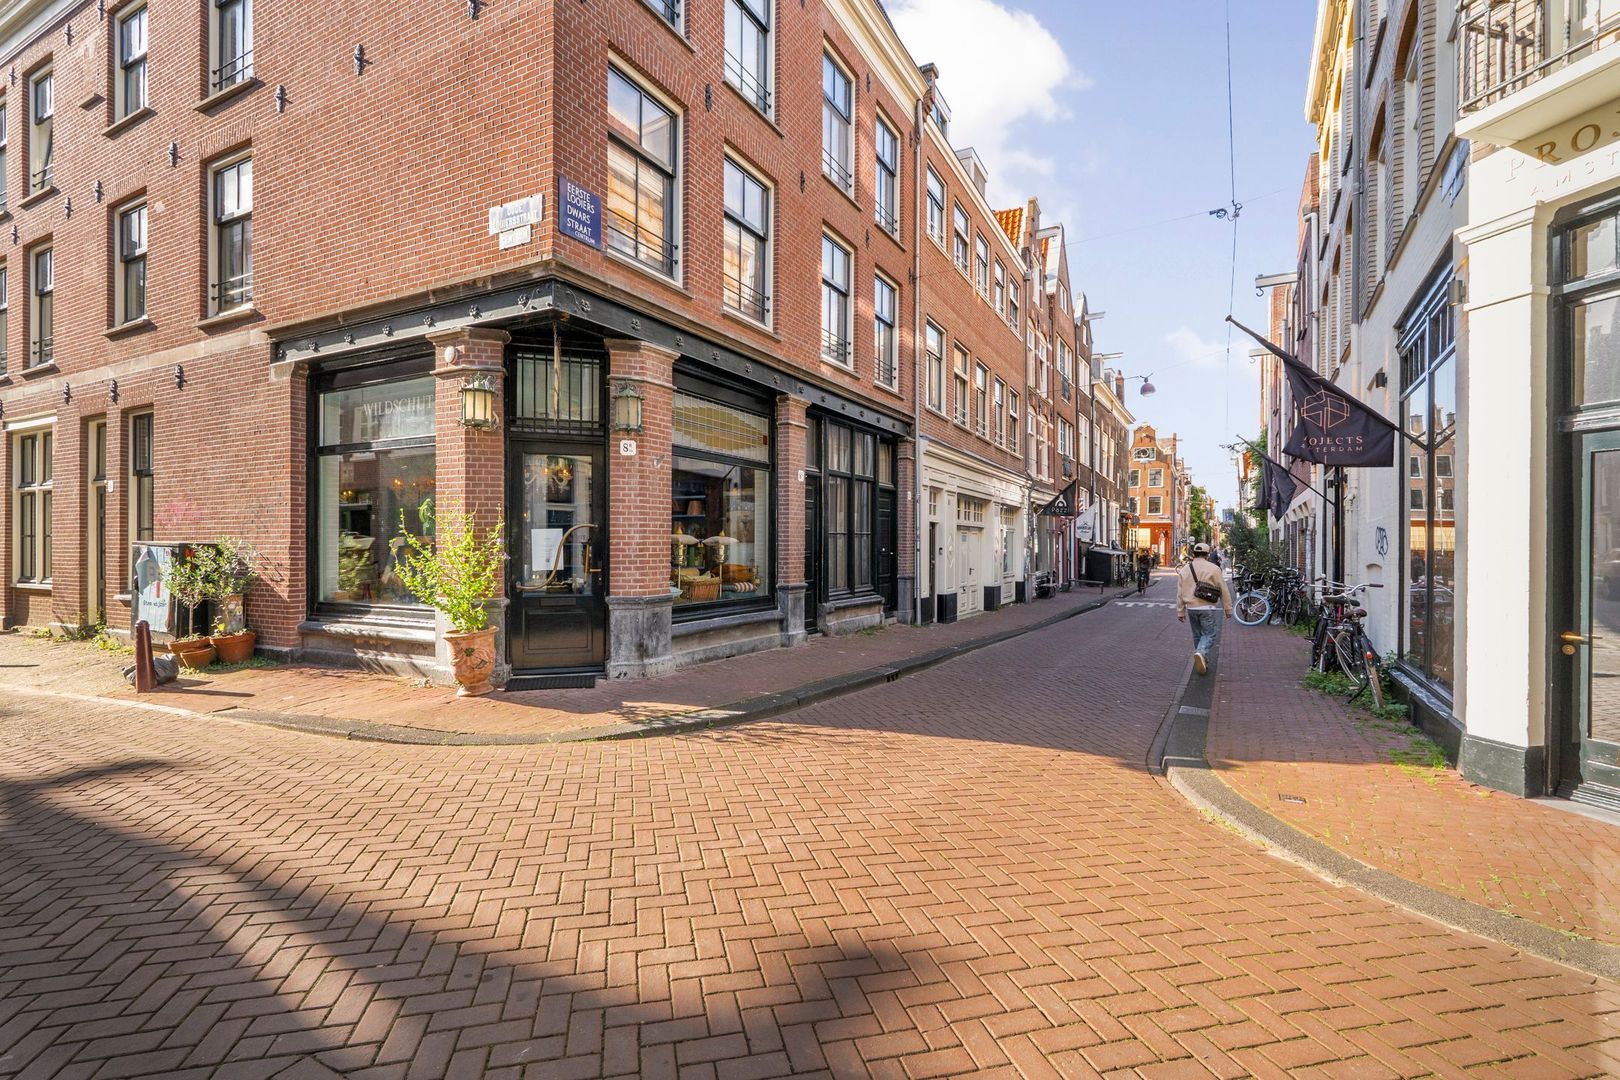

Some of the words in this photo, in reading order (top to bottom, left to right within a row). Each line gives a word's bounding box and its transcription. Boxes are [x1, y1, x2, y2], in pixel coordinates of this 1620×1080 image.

[567, 182, 591, 203] EERSTE
[567, 191, 595, 214] LOOIERS
[567, 204, 591, 224] DWARS
[567, 217, 592, 237] STRAAT
[574, 230, 595, 245] CENTRUM
[363, 394, 434, 417] WILDSCHUT
[1300, 443, 1363, 453] ATERDAM
[1303, 435, 1363, 446] OJECTS
